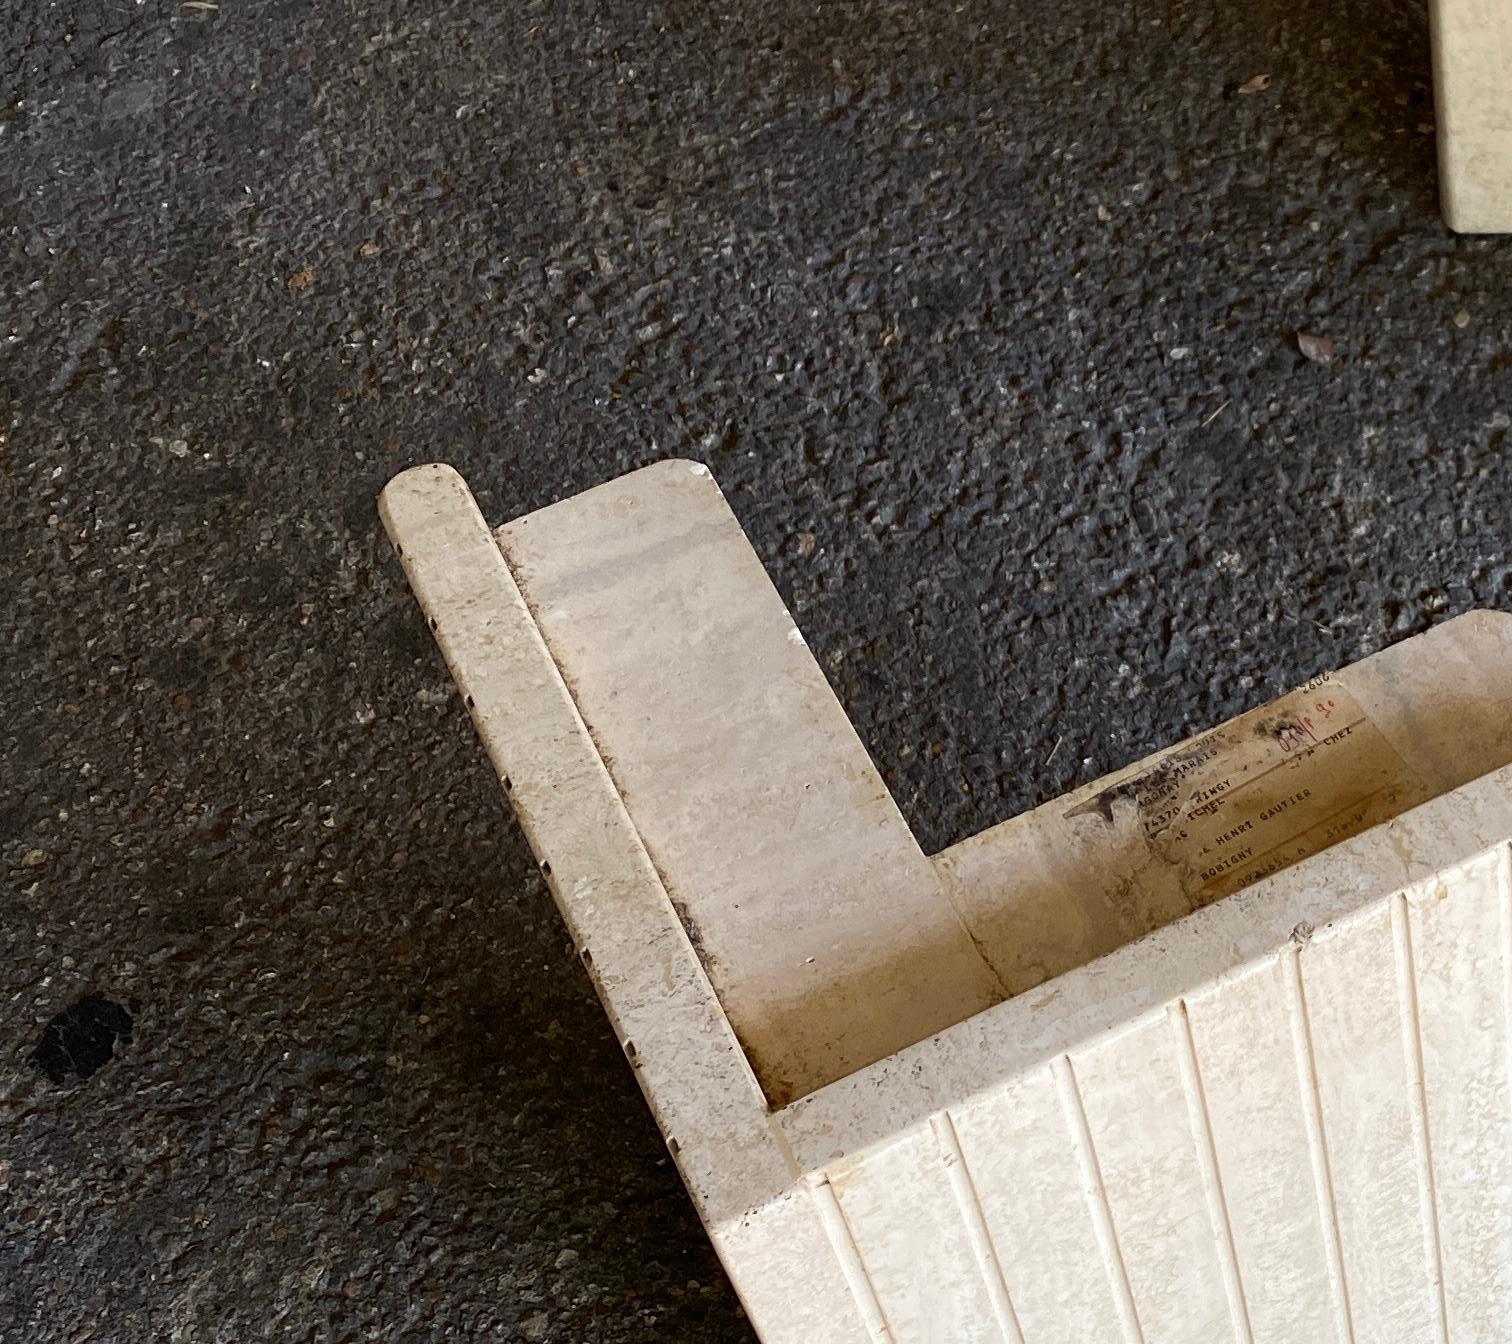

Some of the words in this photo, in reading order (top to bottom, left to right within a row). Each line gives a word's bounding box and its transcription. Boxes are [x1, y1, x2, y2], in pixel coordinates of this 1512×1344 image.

[1323, 727, 1352, 746] CHEZ
[1185, 796, 1225, 824] ICHEL
[1215, 820, 1254, 846] HENRI
[1259, 788, 1312, 821] GAUTIER
[1200, 846, 1253, 881] BOBIGNY
